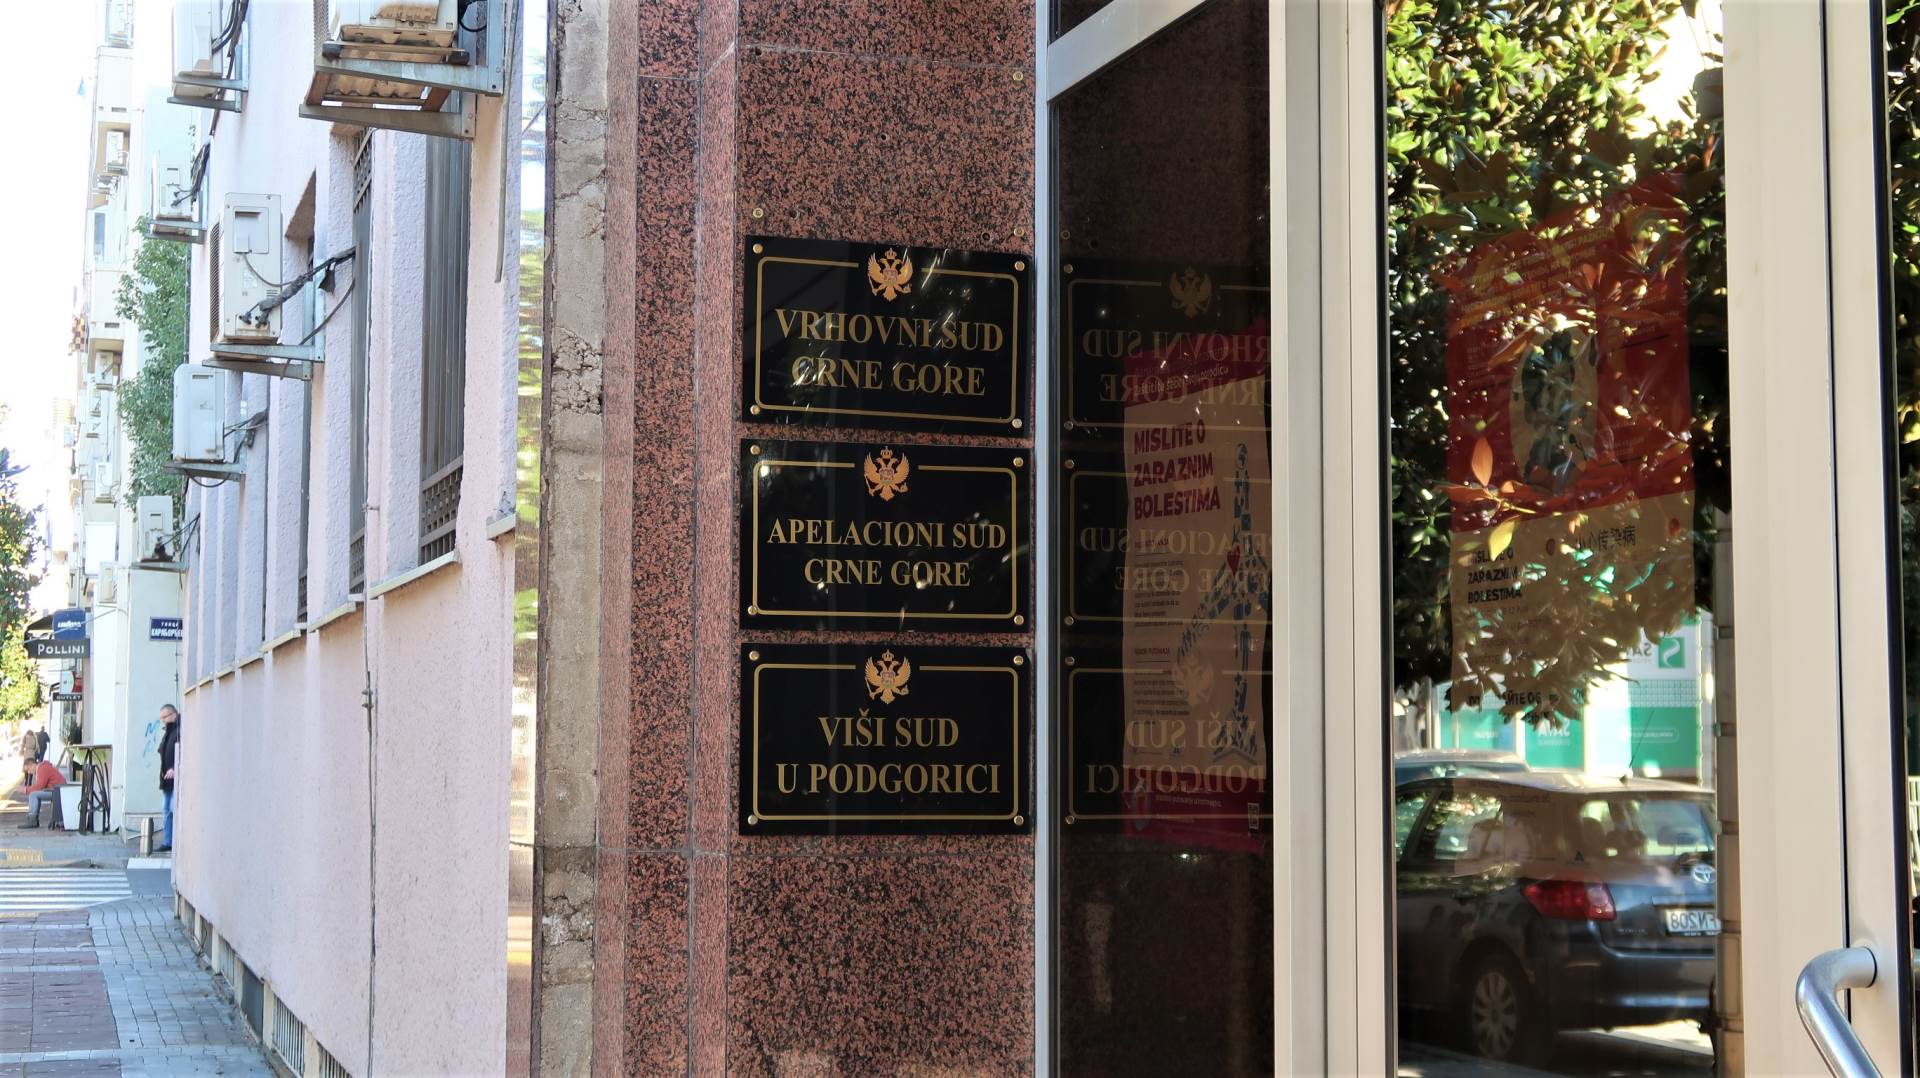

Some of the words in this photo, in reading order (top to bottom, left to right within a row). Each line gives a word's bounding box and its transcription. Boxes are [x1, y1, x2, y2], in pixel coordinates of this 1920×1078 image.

[775, 308, 932, 348] VRHOVNI
[942, 319, 1004, 351] SUD
[792, 355, 882, 389] CRNE
[893, 361, 985, 396] GORE
[1134, 422, 1193, 455] MISLITE
[1196, 418, 1206, 444] O
[1133, 452, 1214, 488] ZARAZNIM
[1134, 486, 1221, 521] BOLESTIMA
[767, 518, 945, 548] APELACIONI
[953, 522, 1006, 549] SUD
[804, 558, 882, 585] CRNE
[891, 561, 971, 587] GORE
[37, 644, 85, 655] POLLINI
[818, 707, 888, 747] VIŠI
[895, 717, 960, 747] SUD
[776, 763, 799, 793] U
[808, 763, 1000, 793] PODGORICI
